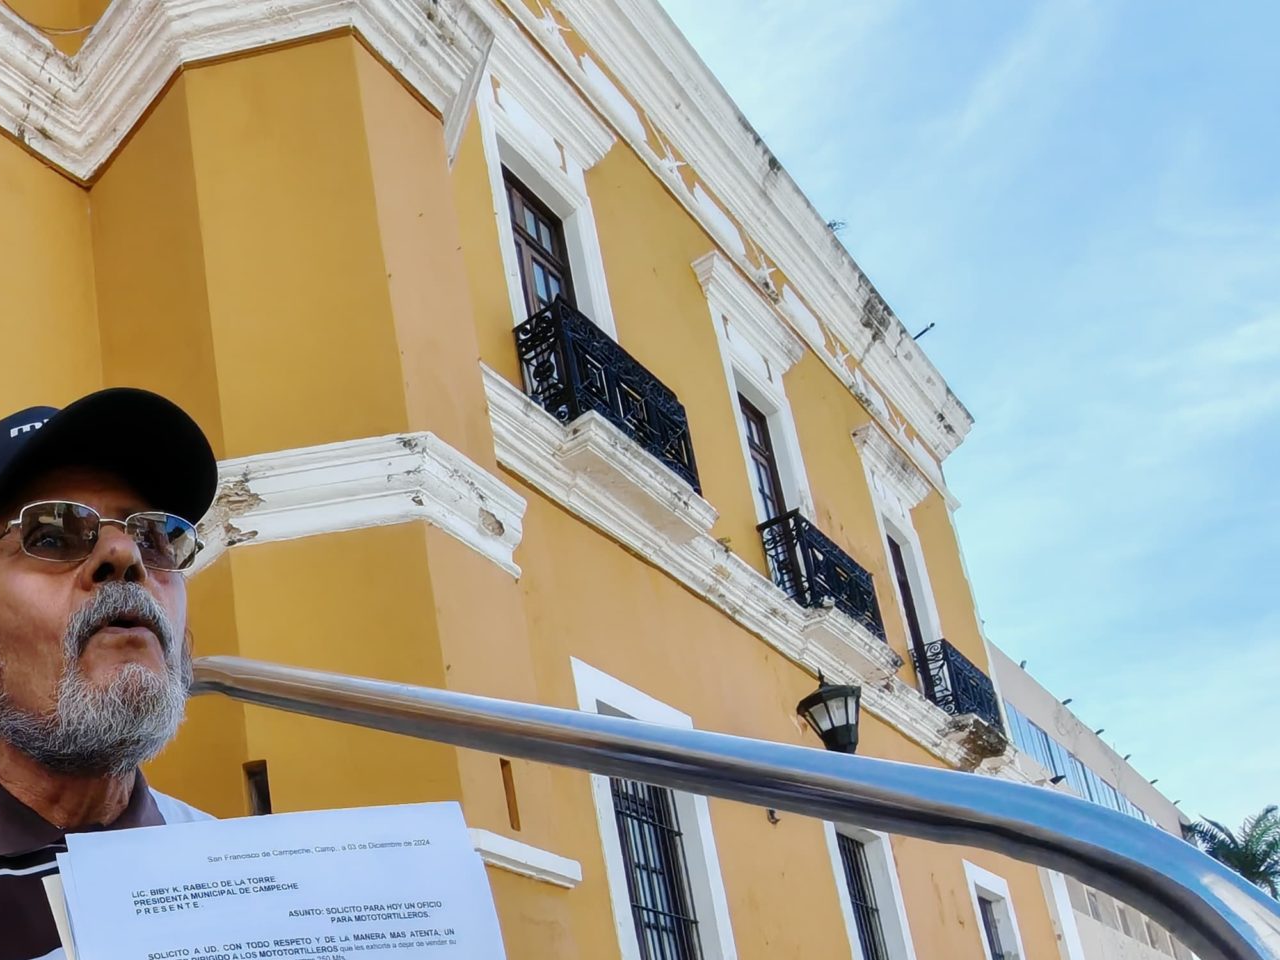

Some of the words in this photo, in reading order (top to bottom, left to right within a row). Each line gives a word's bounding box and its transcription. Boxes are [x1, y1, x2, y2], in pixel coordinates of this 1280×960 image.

[131, 889, 148, 898] LIC.
[149, 886, 169, 896] BIBY
[172, 885, 181, 893] K.
[182, 880, 218, 891] RABELO
[220, 879, 232, 887] DE
[233, 878, 245, 886] LA
[247, 874, 276, 885] TORRE
[133, 893, 189, 906] PRESIDENTA
[190, 887, 236, 899] MUNICIPAL
[252, 881, 299, 893] CAMPECHE
[288, 907, 324, 917] ASUNTO:
[325, 905, 362, 914] SOLICITO
[363, 903, 385, 912] PARA
[386, 902, 402, 910] HOY
[404, 901, 415, 909] UN
[416, 900, 442, 908] OFICIO
[354, 910, 430, 922] MOTOTORTILLEROS.
[148, 948, 189, 959] SOLICITO
[204, 945, 220, 953] UD.
[222, 943, 242, 952] CON
[245, 940, 270, 950] TODO
[273, 937, 312, 947] RESPETO
[353, 931, 386, 941] MANERA
[389, 930, 406, 938] MAS
[240, 950, 257, 960] LOS
[259, 943, 338, 958] MOTOTORTILLEROS
